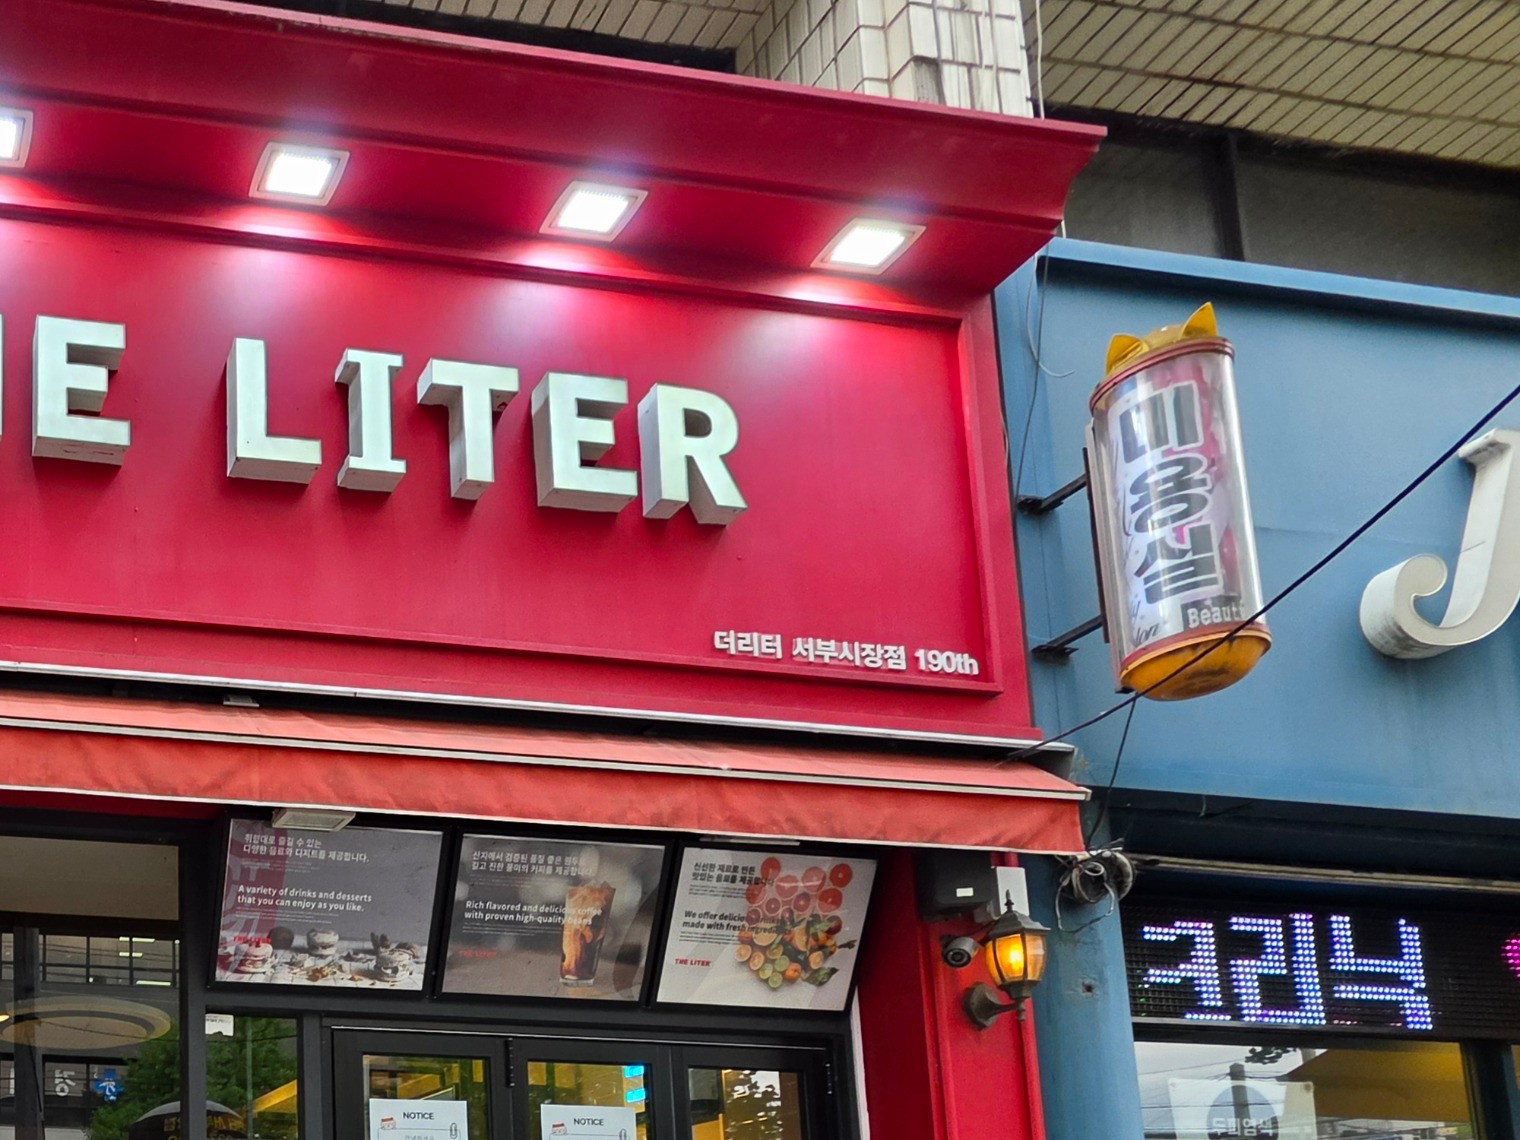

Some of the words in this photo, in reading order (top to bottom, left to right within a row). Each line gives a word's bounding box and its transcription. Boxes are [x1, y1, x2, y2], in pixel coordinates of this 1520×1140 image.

[226, 337, 748, 525] LITER
[713, 630, 782, 659] 더리터
[791, 637, 907, 670] 서부시장점
[914, 649, 980, 676] 190th
[243, 845, 267, 855] 다양한
[238, 885, 245, 893] A
[246, 886, 277, 897] variety
[278, 888, 288, 896] of
[289, 888, 317, 898] drinks
[318, 891, 335, 900] and
[336, 892, 372, 902] desserts
[237, 895, 256, 904] that
[257, 897, 274, 906] you
[275, 899, 291, 907] can
[292, 899, 317, 910] enjoy
[318, 901, 327, 909] as
[329, 903, 345, 911] you
[346, 902, 365, 912] like.
[466, 901, 485, 909] Rich
[486, 902, 521, 911] flavored
[522, 903, 538, 912] and
[464, 911, 484, 919] with
[485, 912, 515, 922] proven
[516, 913, 565, 925] high-quality
[684, 910, 696, 919] We
[698, 911, 718, 920] offer
[719, 912, 759, 922] delicio
[682, 920, 705, 928] made
[706, 921, 725, 930] with
[726, 922, 747, 931] fresh
[675, 958, 689, 966] THE
[690, 959, 712, 967] LITER
[403, 1112, 435, 1120] NOTICE
[573, 1118, 604, 1126] NOTICE
